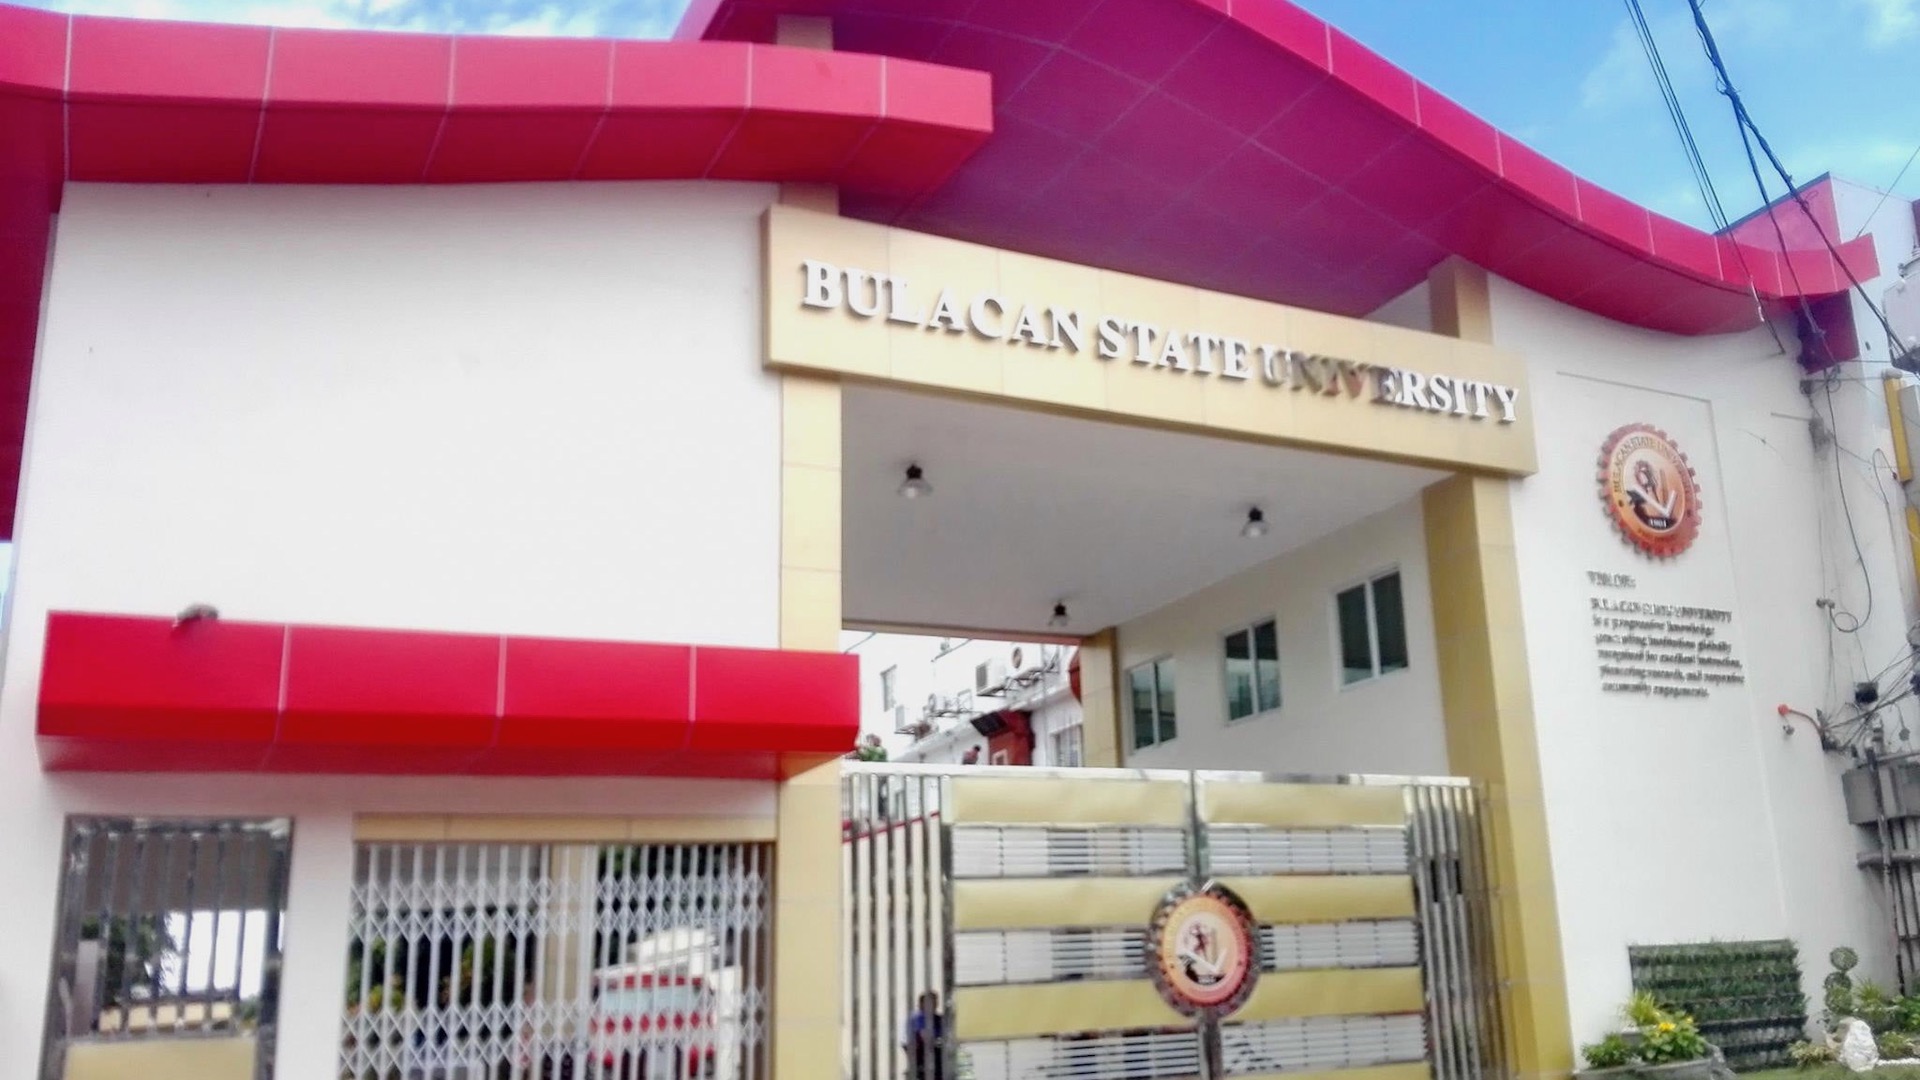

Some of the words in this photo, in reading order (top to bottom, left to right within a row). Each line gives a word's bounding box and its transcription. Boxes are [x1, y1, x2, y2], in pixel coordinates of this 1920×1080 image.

[801, 259, 1081, 352] BULACAN
[1097, 313, 1252, 380] STATE
[1257, 343, 1519, 423] UNIVERSITY
